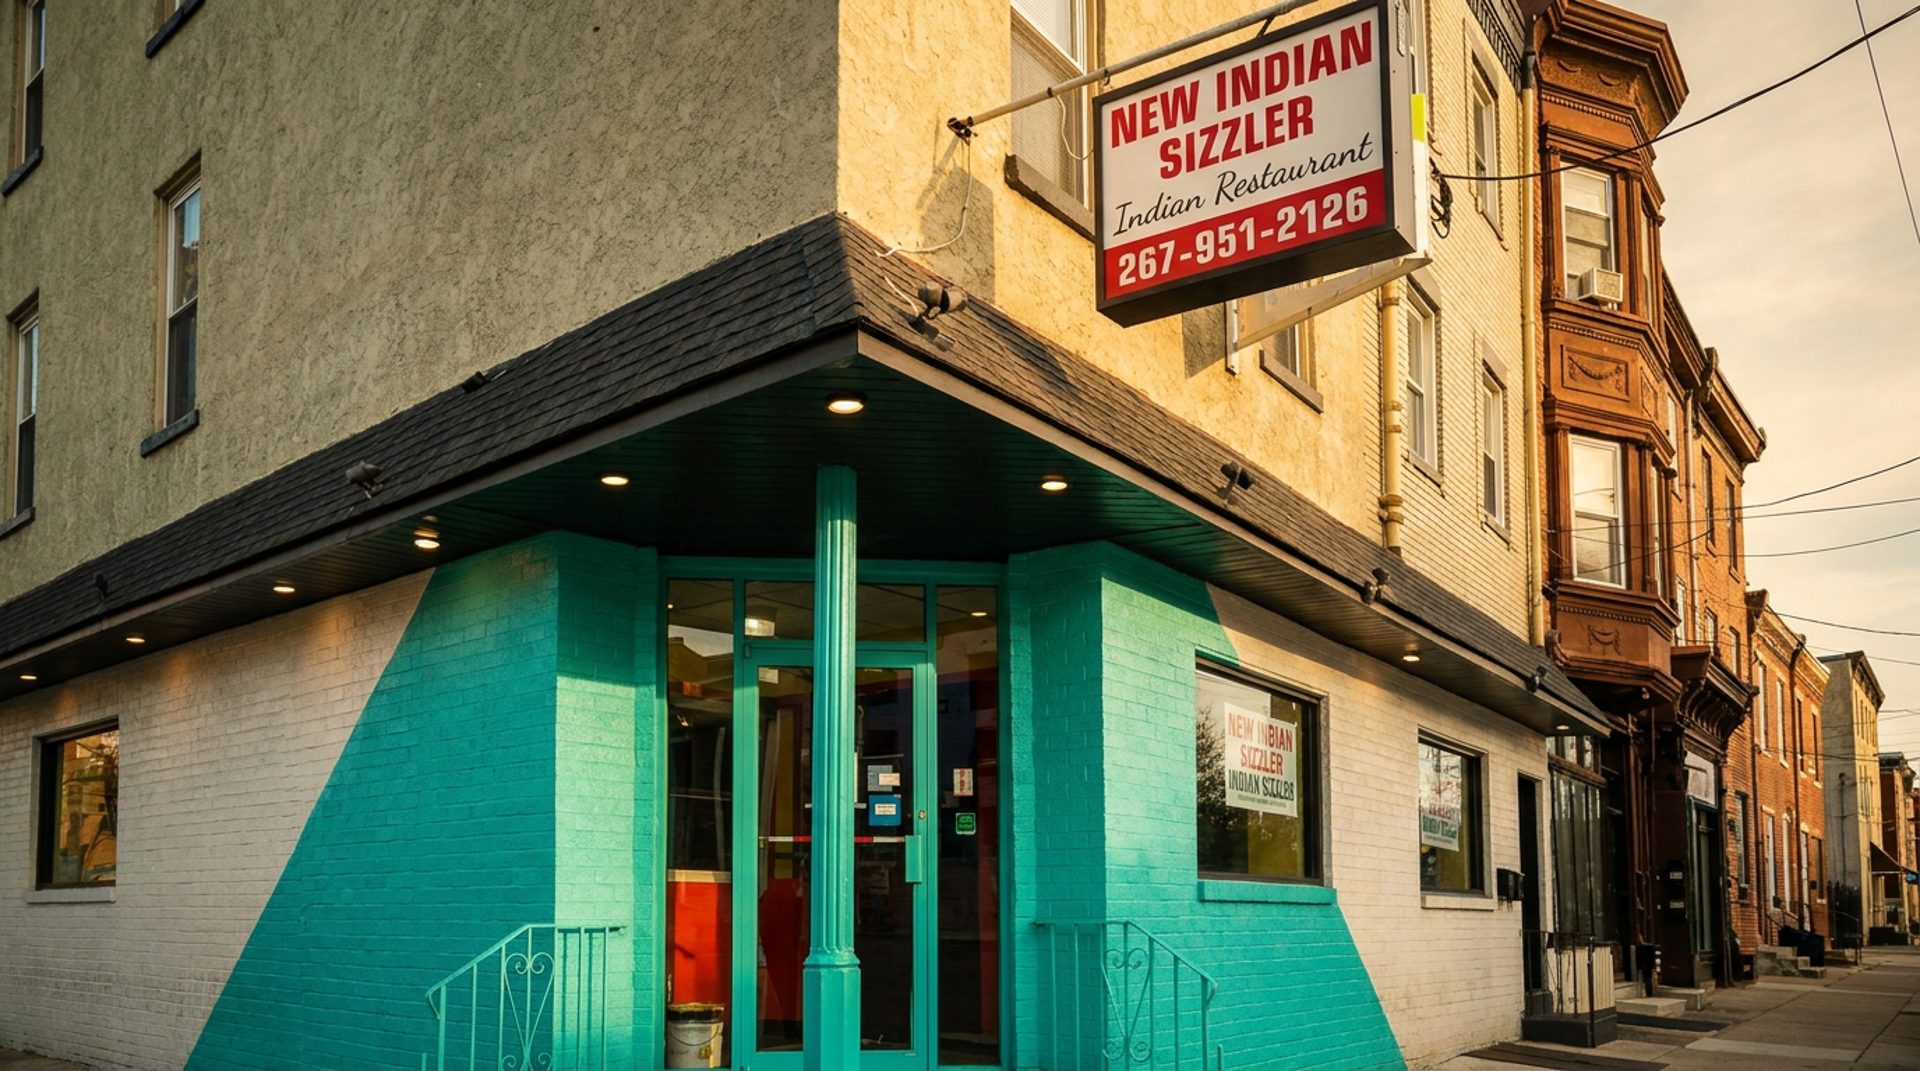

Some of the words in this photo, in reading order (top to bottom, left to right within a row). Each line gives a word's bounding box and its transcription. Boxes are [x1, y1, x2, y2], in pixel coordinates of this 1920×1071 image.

[1111, 81, 1200, 148] NEW
[1216, 20, 1373, 112] INDIAN
[1112, 193, 1205, 237] Indian
[1215, 132, 1374, 206] Restaurant
[1159, 95, 1314, 179] SIZZLER
[1118, 186, 1368, 287] 267-951-2126
[1228, 712, 1254, 740] NEW
